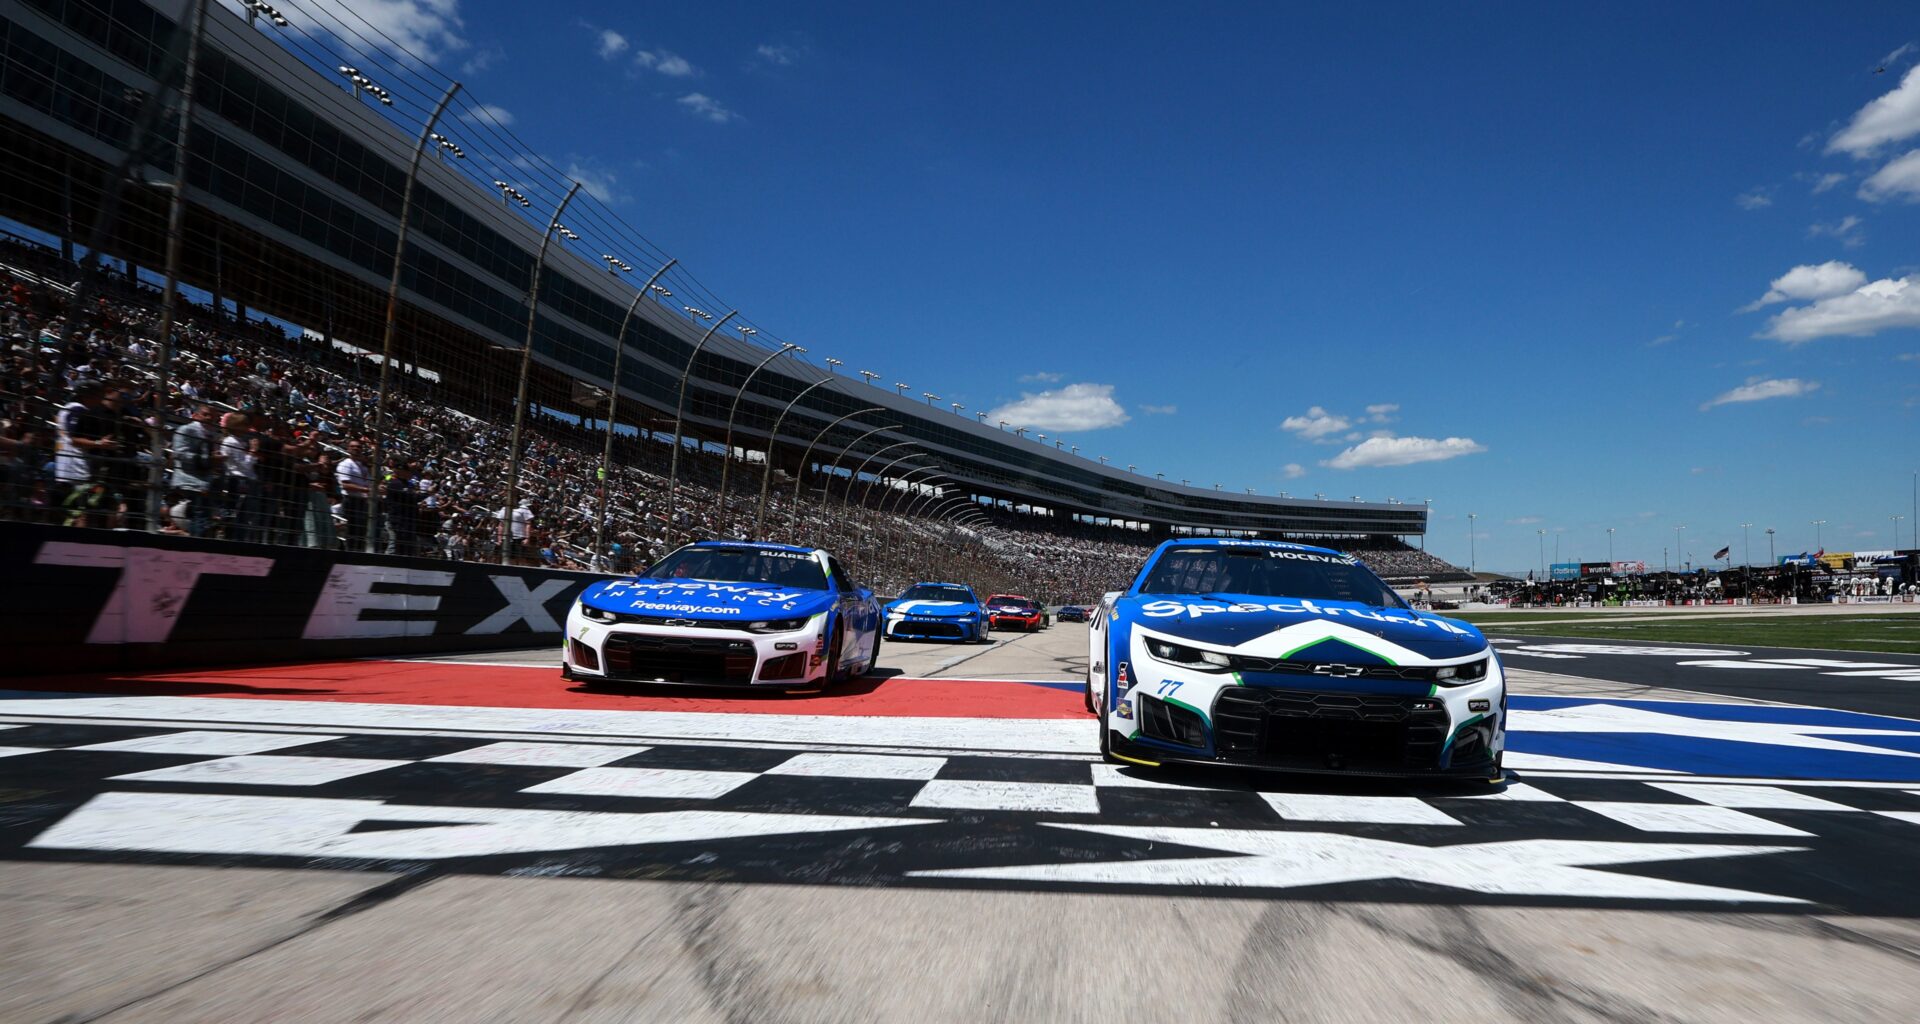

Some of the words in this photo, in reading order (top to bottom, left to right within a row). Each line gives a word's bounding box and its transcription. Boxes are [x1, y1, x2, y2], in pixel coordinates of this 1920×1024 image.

[1269, 551, 1356, 566] HOCEVAR
[604, 580, 802, 601] Freeway
[593, 590, 792, 611] INSURANCE
[630, 600, 740, 615] Freeway.com
[1142, 600, 1453, 633] Spectrum
[579, 626, 590, 640] 7
[1157, 679, 1184, 697] 77
